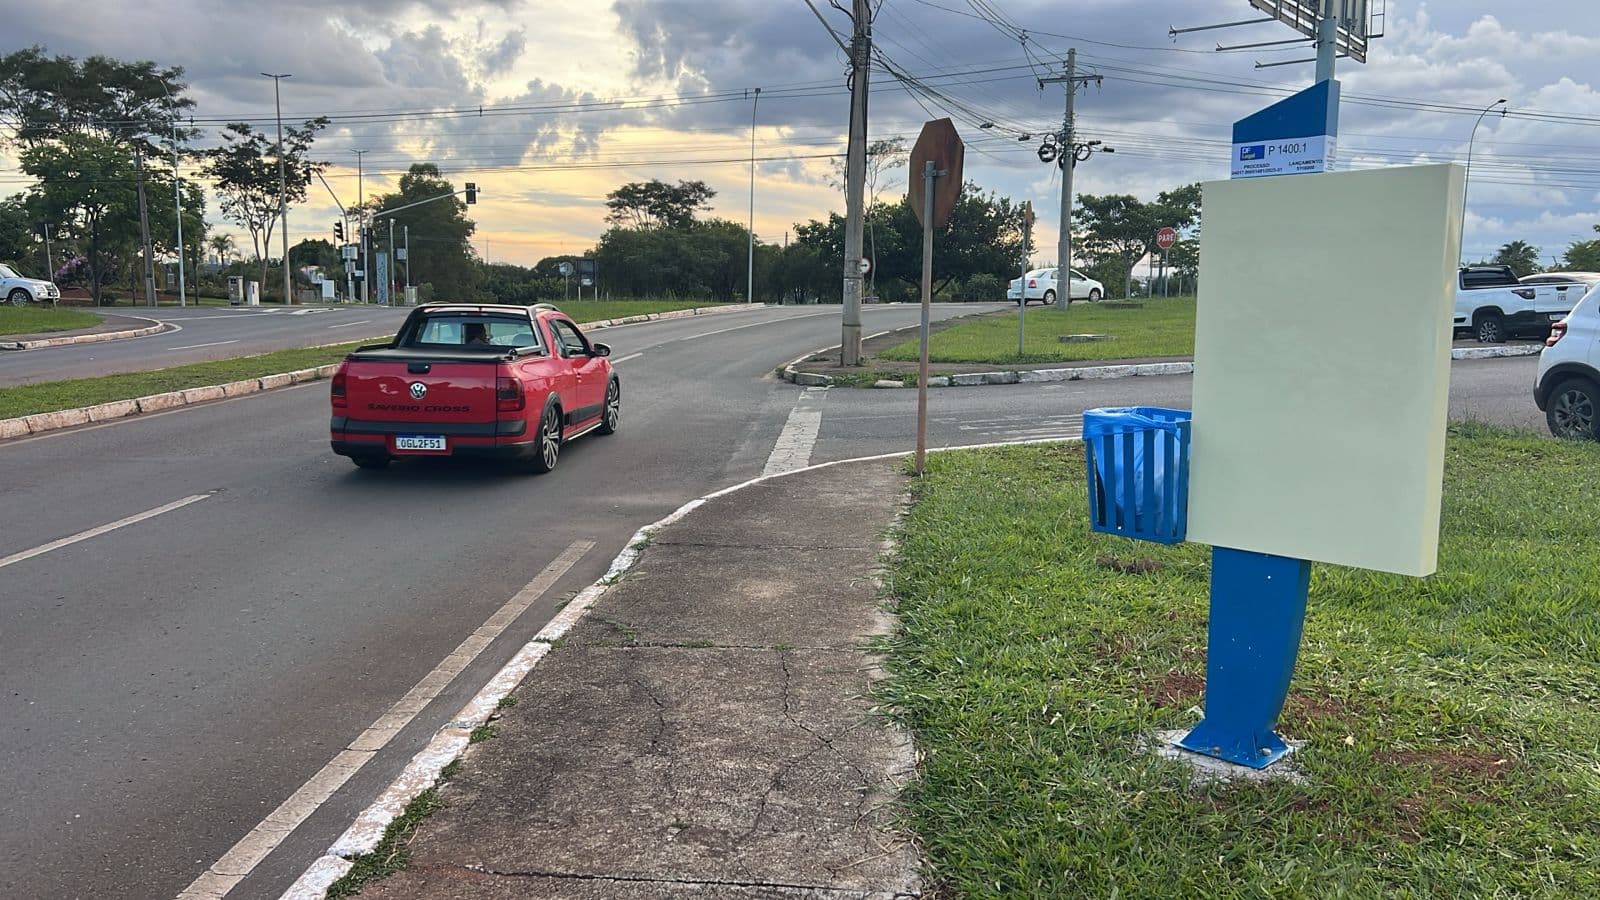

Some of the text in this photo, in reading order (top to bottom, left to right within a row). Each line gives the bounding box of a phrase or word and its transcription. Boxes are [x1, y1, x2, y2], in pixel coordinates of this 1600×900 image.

[1268, 142, 1306, 155] P 1400.1
[1158, 233, 1174, 242] PARE
[368, 403, 471, 412] SAVEIRO CROSS
